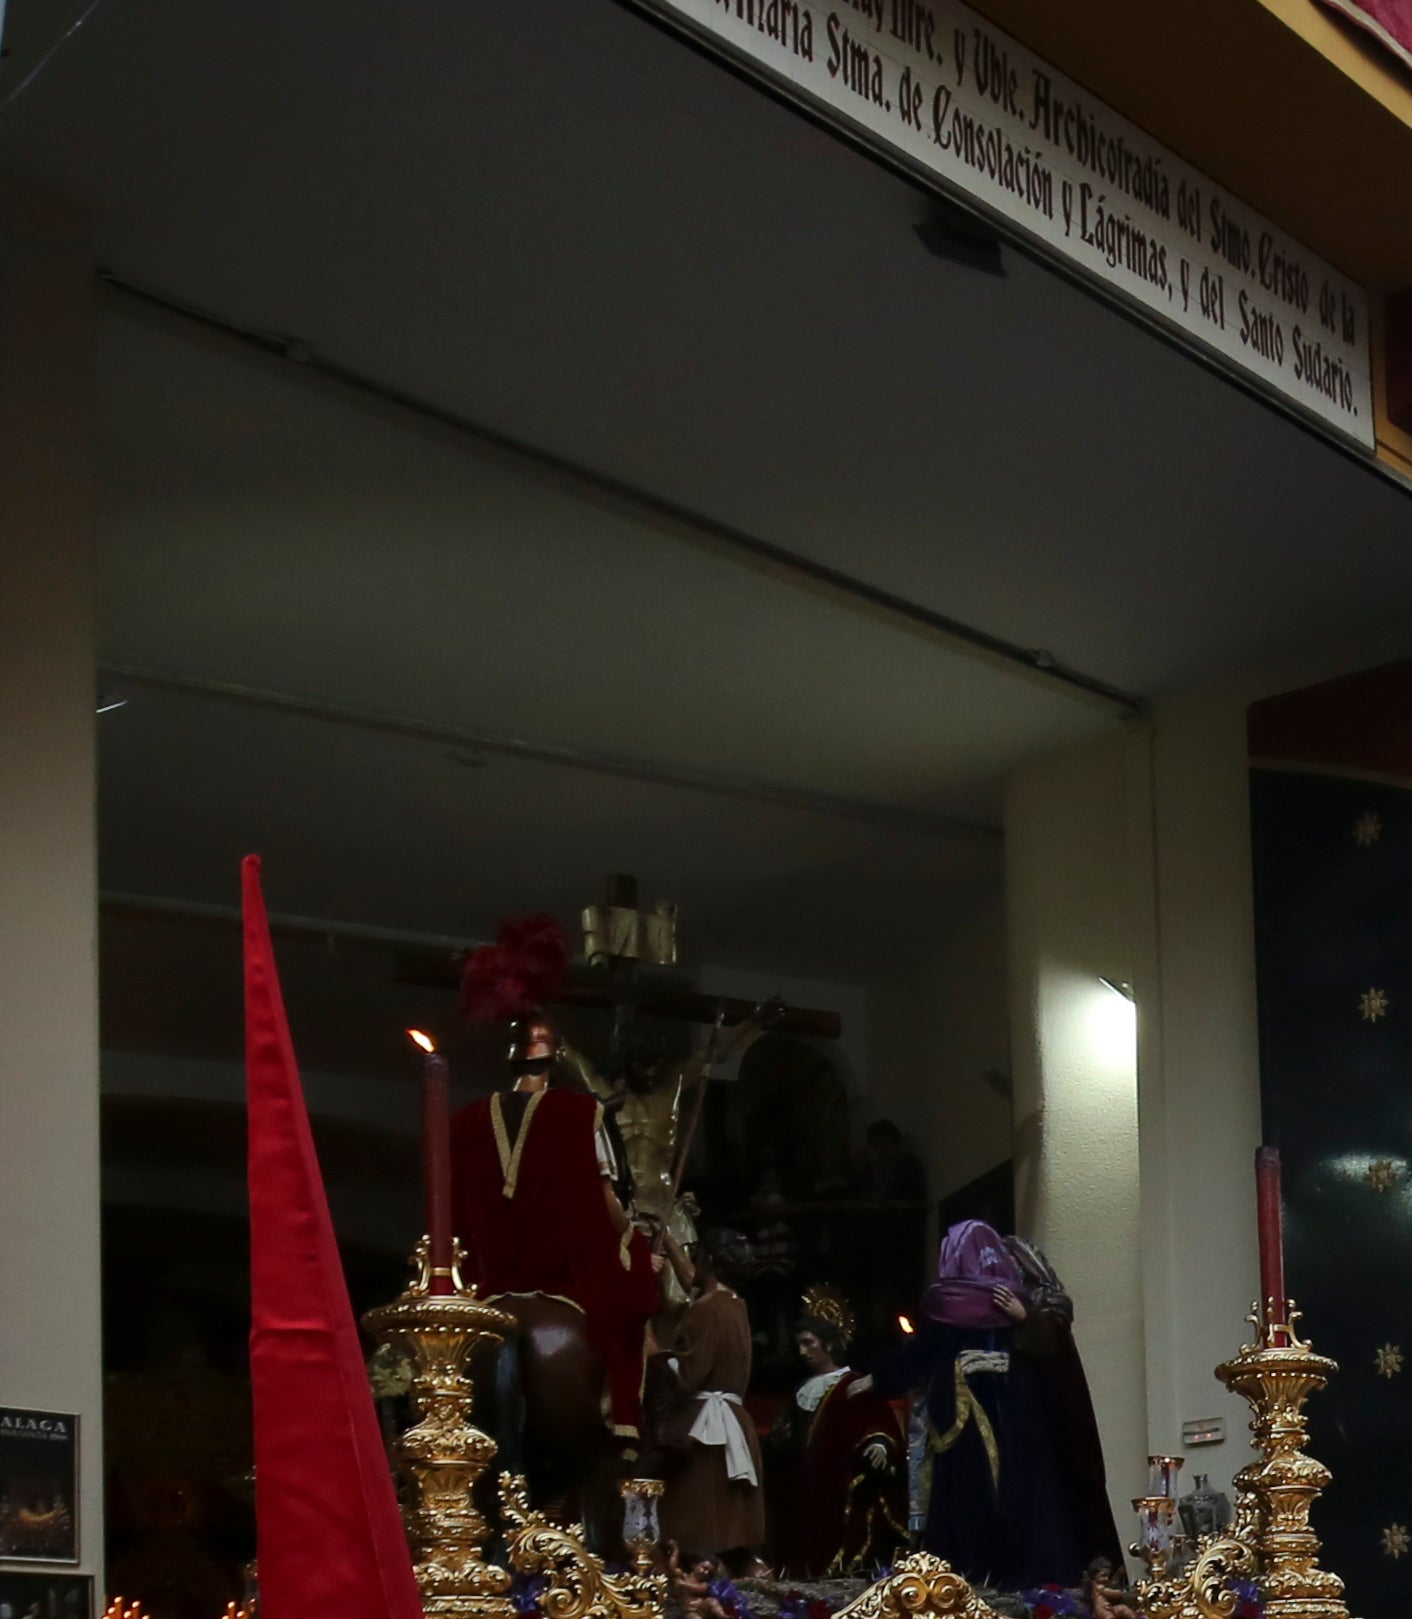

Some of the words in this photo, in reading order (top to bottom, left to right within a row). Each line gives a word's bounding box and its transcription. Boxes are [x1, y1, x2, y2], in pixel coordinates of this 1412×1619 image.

[827, 11, 891, 113] Stma.
[899, 66, 923, 132] de
[932, 84, 1053, 220] Consolación
[1061, 180, 1073, 237] y
[1180, 258, 1190, 312] y
[1200, 266, 1225, 330] del
[1238, 289, 1284, 367] Santo
[1292, 324, 1358, 417] Sudario.
[955, 28, 966, 87] y
[1029, 68, 1170, 221] Archicofradía
[1177, 178, 1201, 243] del
[1258, 231, 1309, 314] Cristo
[1319, 279, 1336, 334] de
[1342, 291, 1355, 347] la
